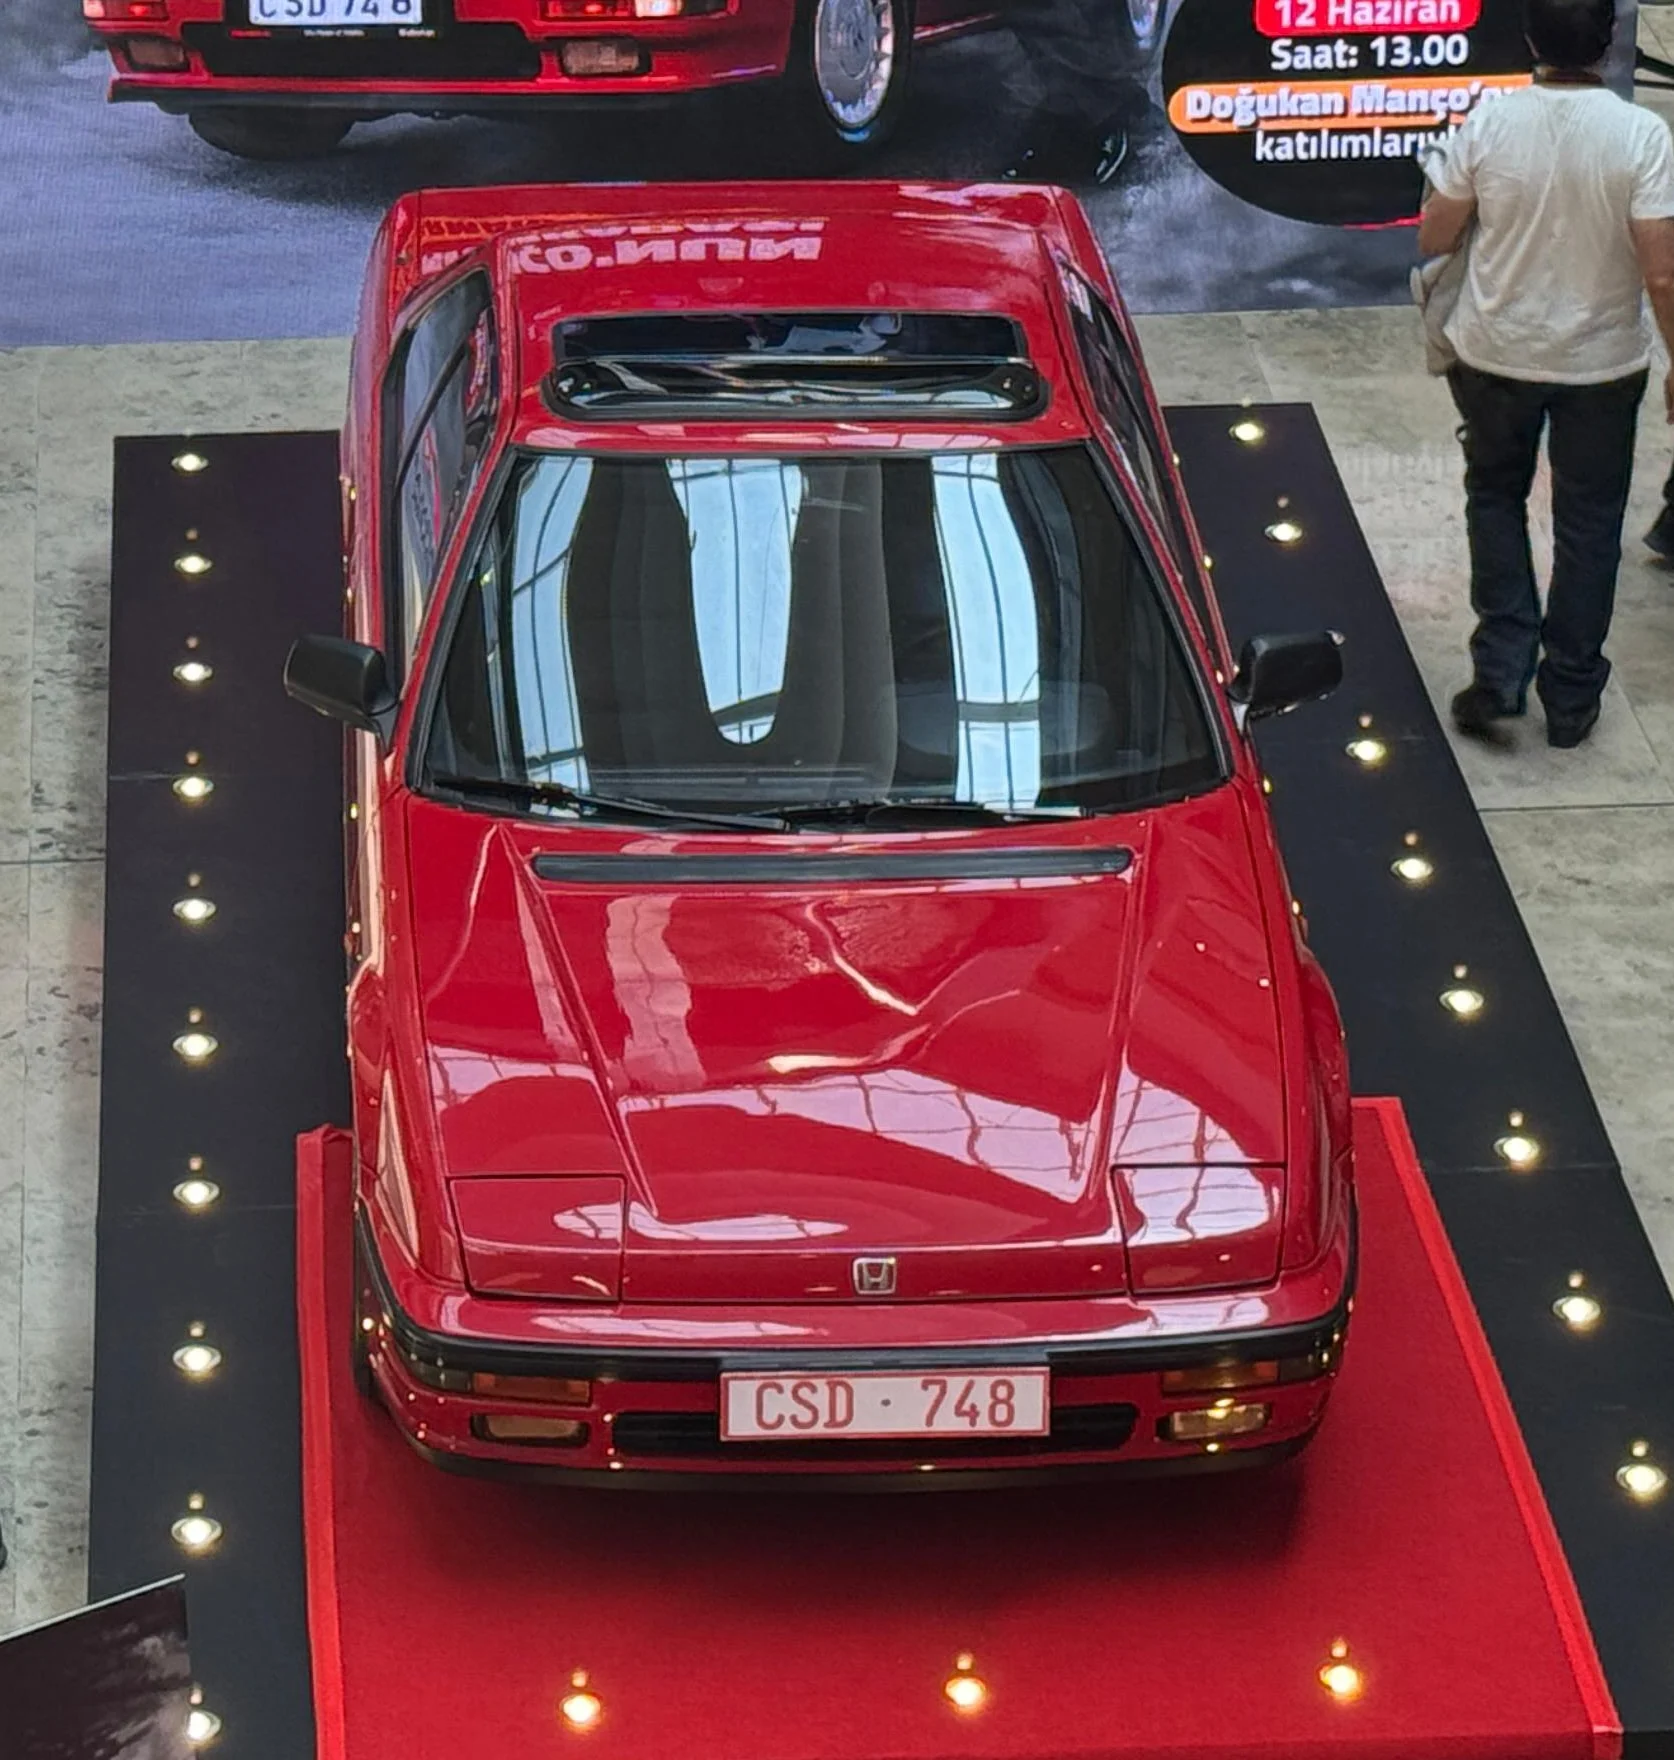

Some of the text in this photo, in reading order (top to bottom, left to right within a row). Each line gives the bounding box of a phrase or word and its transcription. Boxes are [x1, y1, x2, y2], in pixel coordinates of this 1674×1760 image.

[1274, 0, 1461, 28] 12 Haziran
[1270, 33, 1469, 71] Saat: 13.00
[1185, 86, 1345, 128] Doğukan
[755, 1378, 1016, 1430] CSD 748
